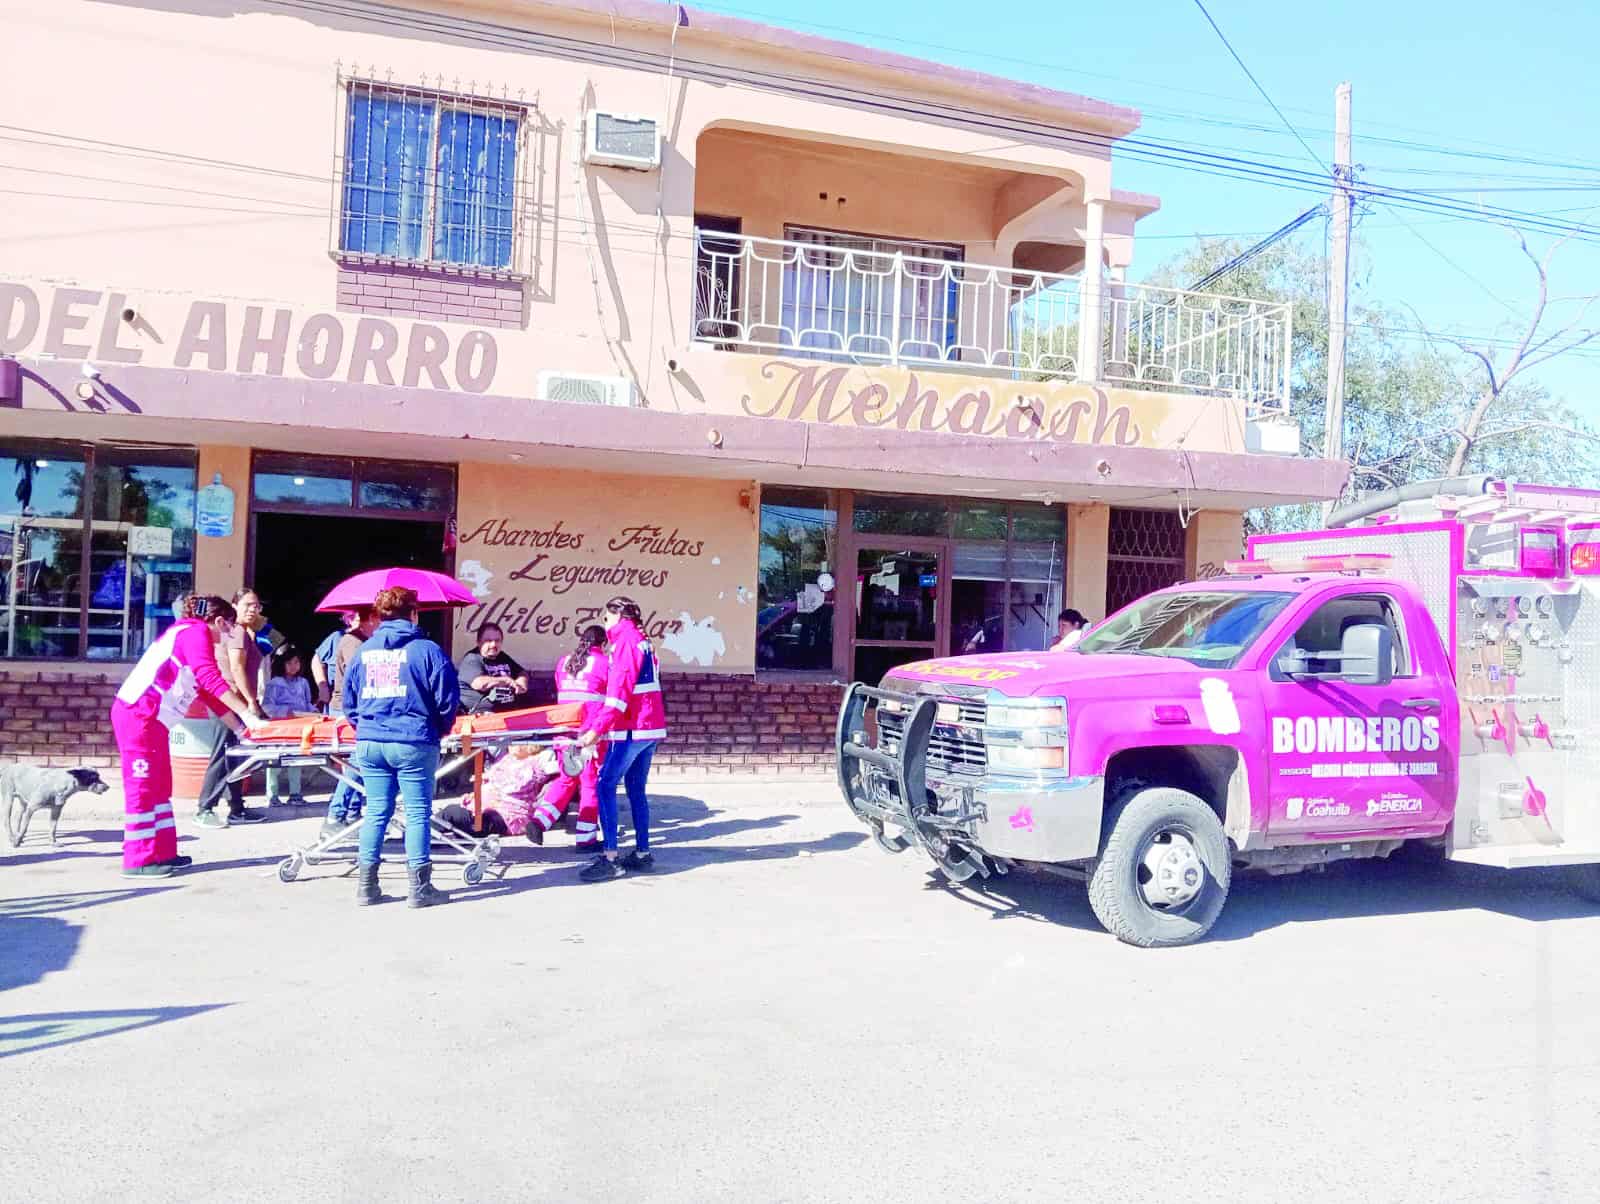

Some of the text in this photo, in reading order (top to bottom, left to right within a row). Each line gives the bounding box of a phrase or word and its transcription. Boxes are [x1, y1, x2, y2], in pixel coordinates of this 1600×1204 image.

[0, 282, 498, 394] DEL AHORRO
[459, 519, 704, 557] Abarrotes Frutas
[510, 553, 669, 594] Legumbres
[1271, 715, 1440, 754] BOMBEROS
